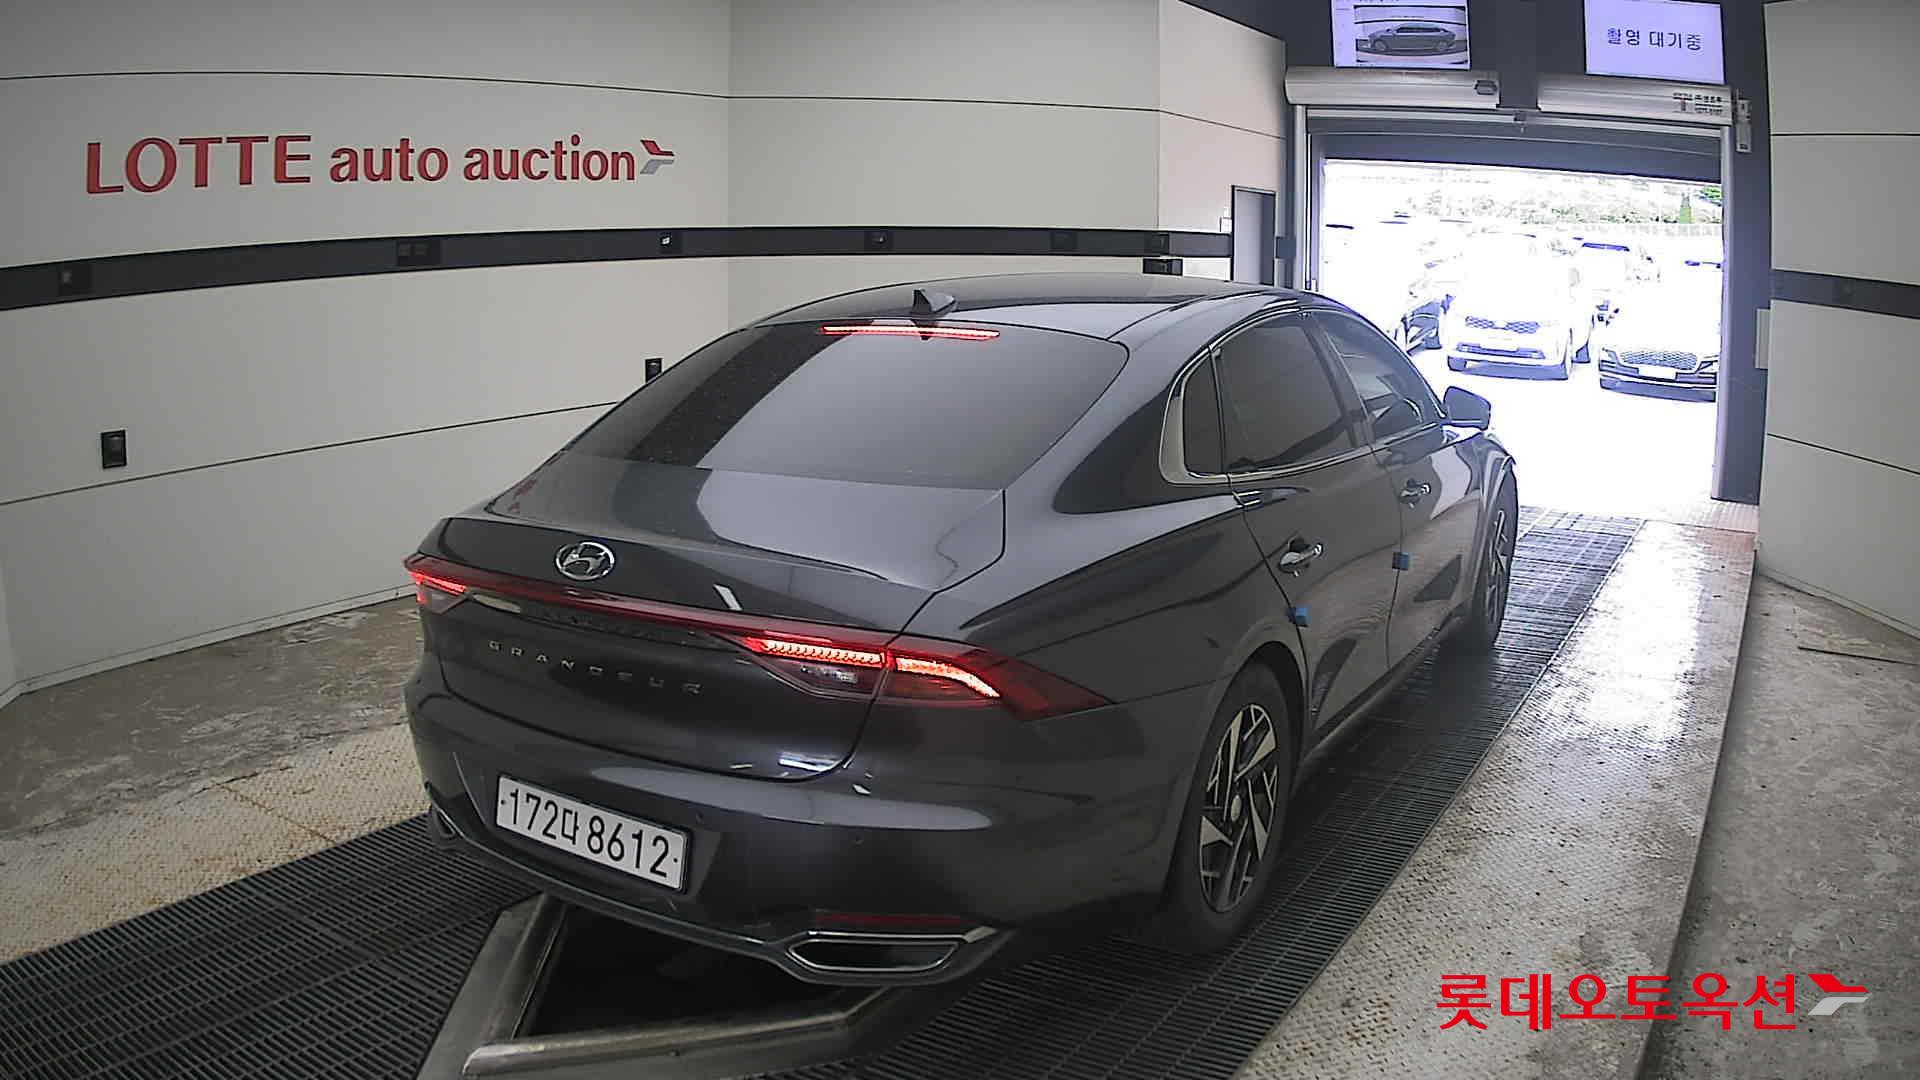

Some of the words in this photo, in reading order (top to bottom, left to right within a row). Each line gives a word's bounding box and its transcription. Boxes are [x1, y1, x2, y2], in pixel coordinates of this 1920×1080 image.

[1648, 31, 1701, 51] 대기중
[86, 134, 312, 195] LOTTE
[329, 137, 449, 183] auto
[463, 133, 636, 182] auction
